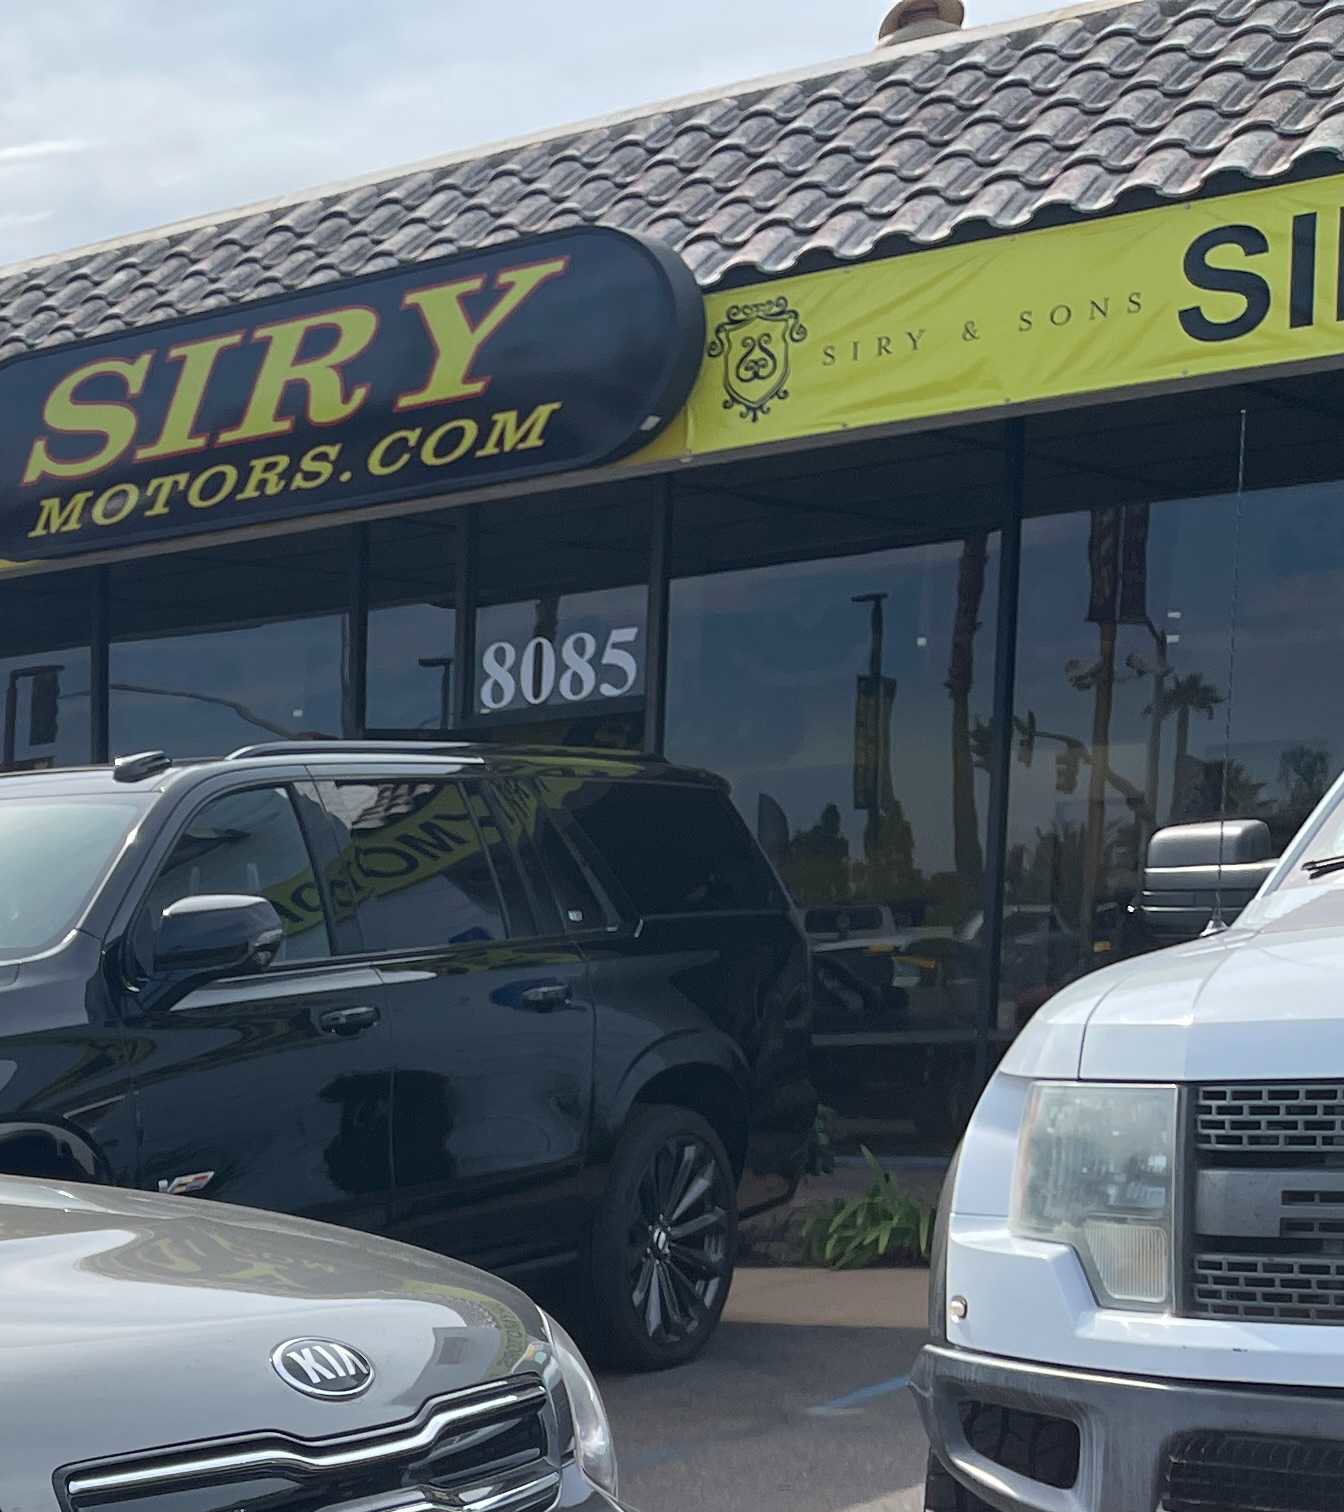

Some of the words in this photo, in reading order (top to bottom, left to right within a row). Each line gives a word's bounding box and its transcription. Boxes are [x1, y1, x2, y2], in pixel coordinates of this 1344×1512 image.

[823, 330, 926, 367] SIRY
[961, 319, 980, 343] &
[1018, 291, 1144, 333] SONS
[1178, 206, 1344, 342] SI
[20, 254, 571, 487] SIRY
[27, 402, 561, 538] MOTORS.COM
[480, 625, 639, 710] 8085
[286, 1342, 370, 1385] KIA
